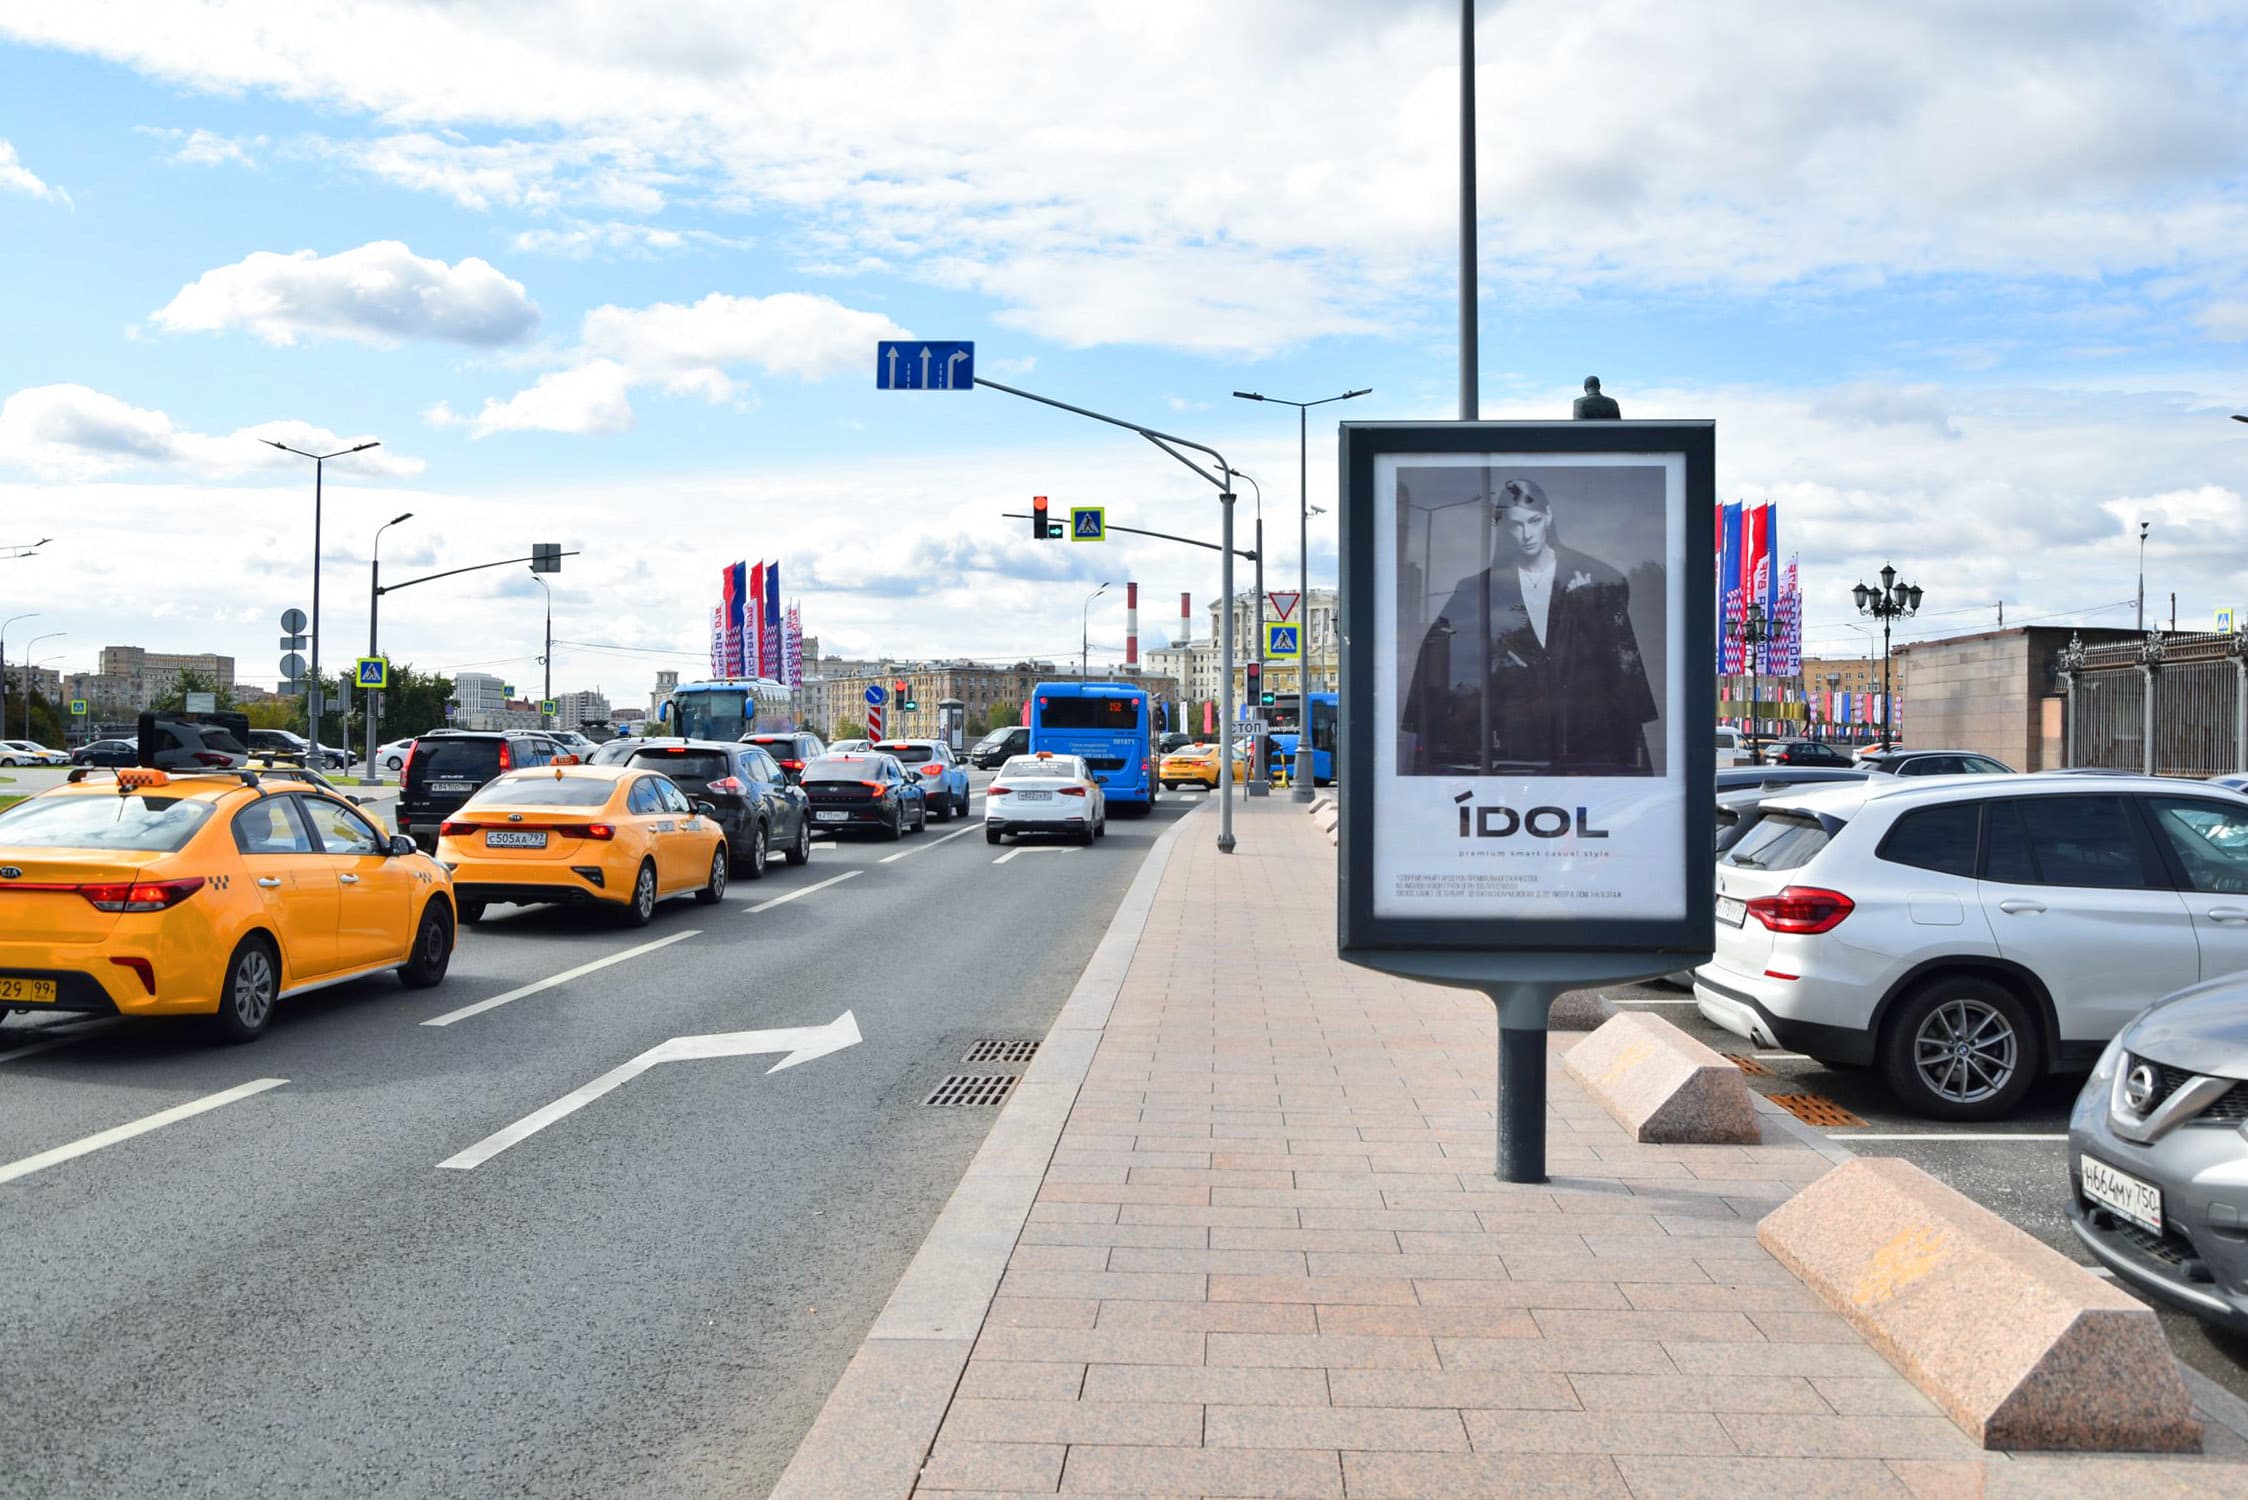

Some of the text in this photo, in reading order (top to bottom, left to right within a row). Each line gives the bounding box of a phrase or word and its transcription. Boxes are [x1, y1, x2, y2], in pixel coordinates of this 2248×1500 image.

[1232, 723, 1261, 733] СТОП
[1458, 850, 1505, 858] premium
[1545, 849, 1579, 857] casual
[1584, 850, 1610, 859] style
[0, 981, 50, 997] 29 99
[2134, 1183, 2157, 1211] 750
